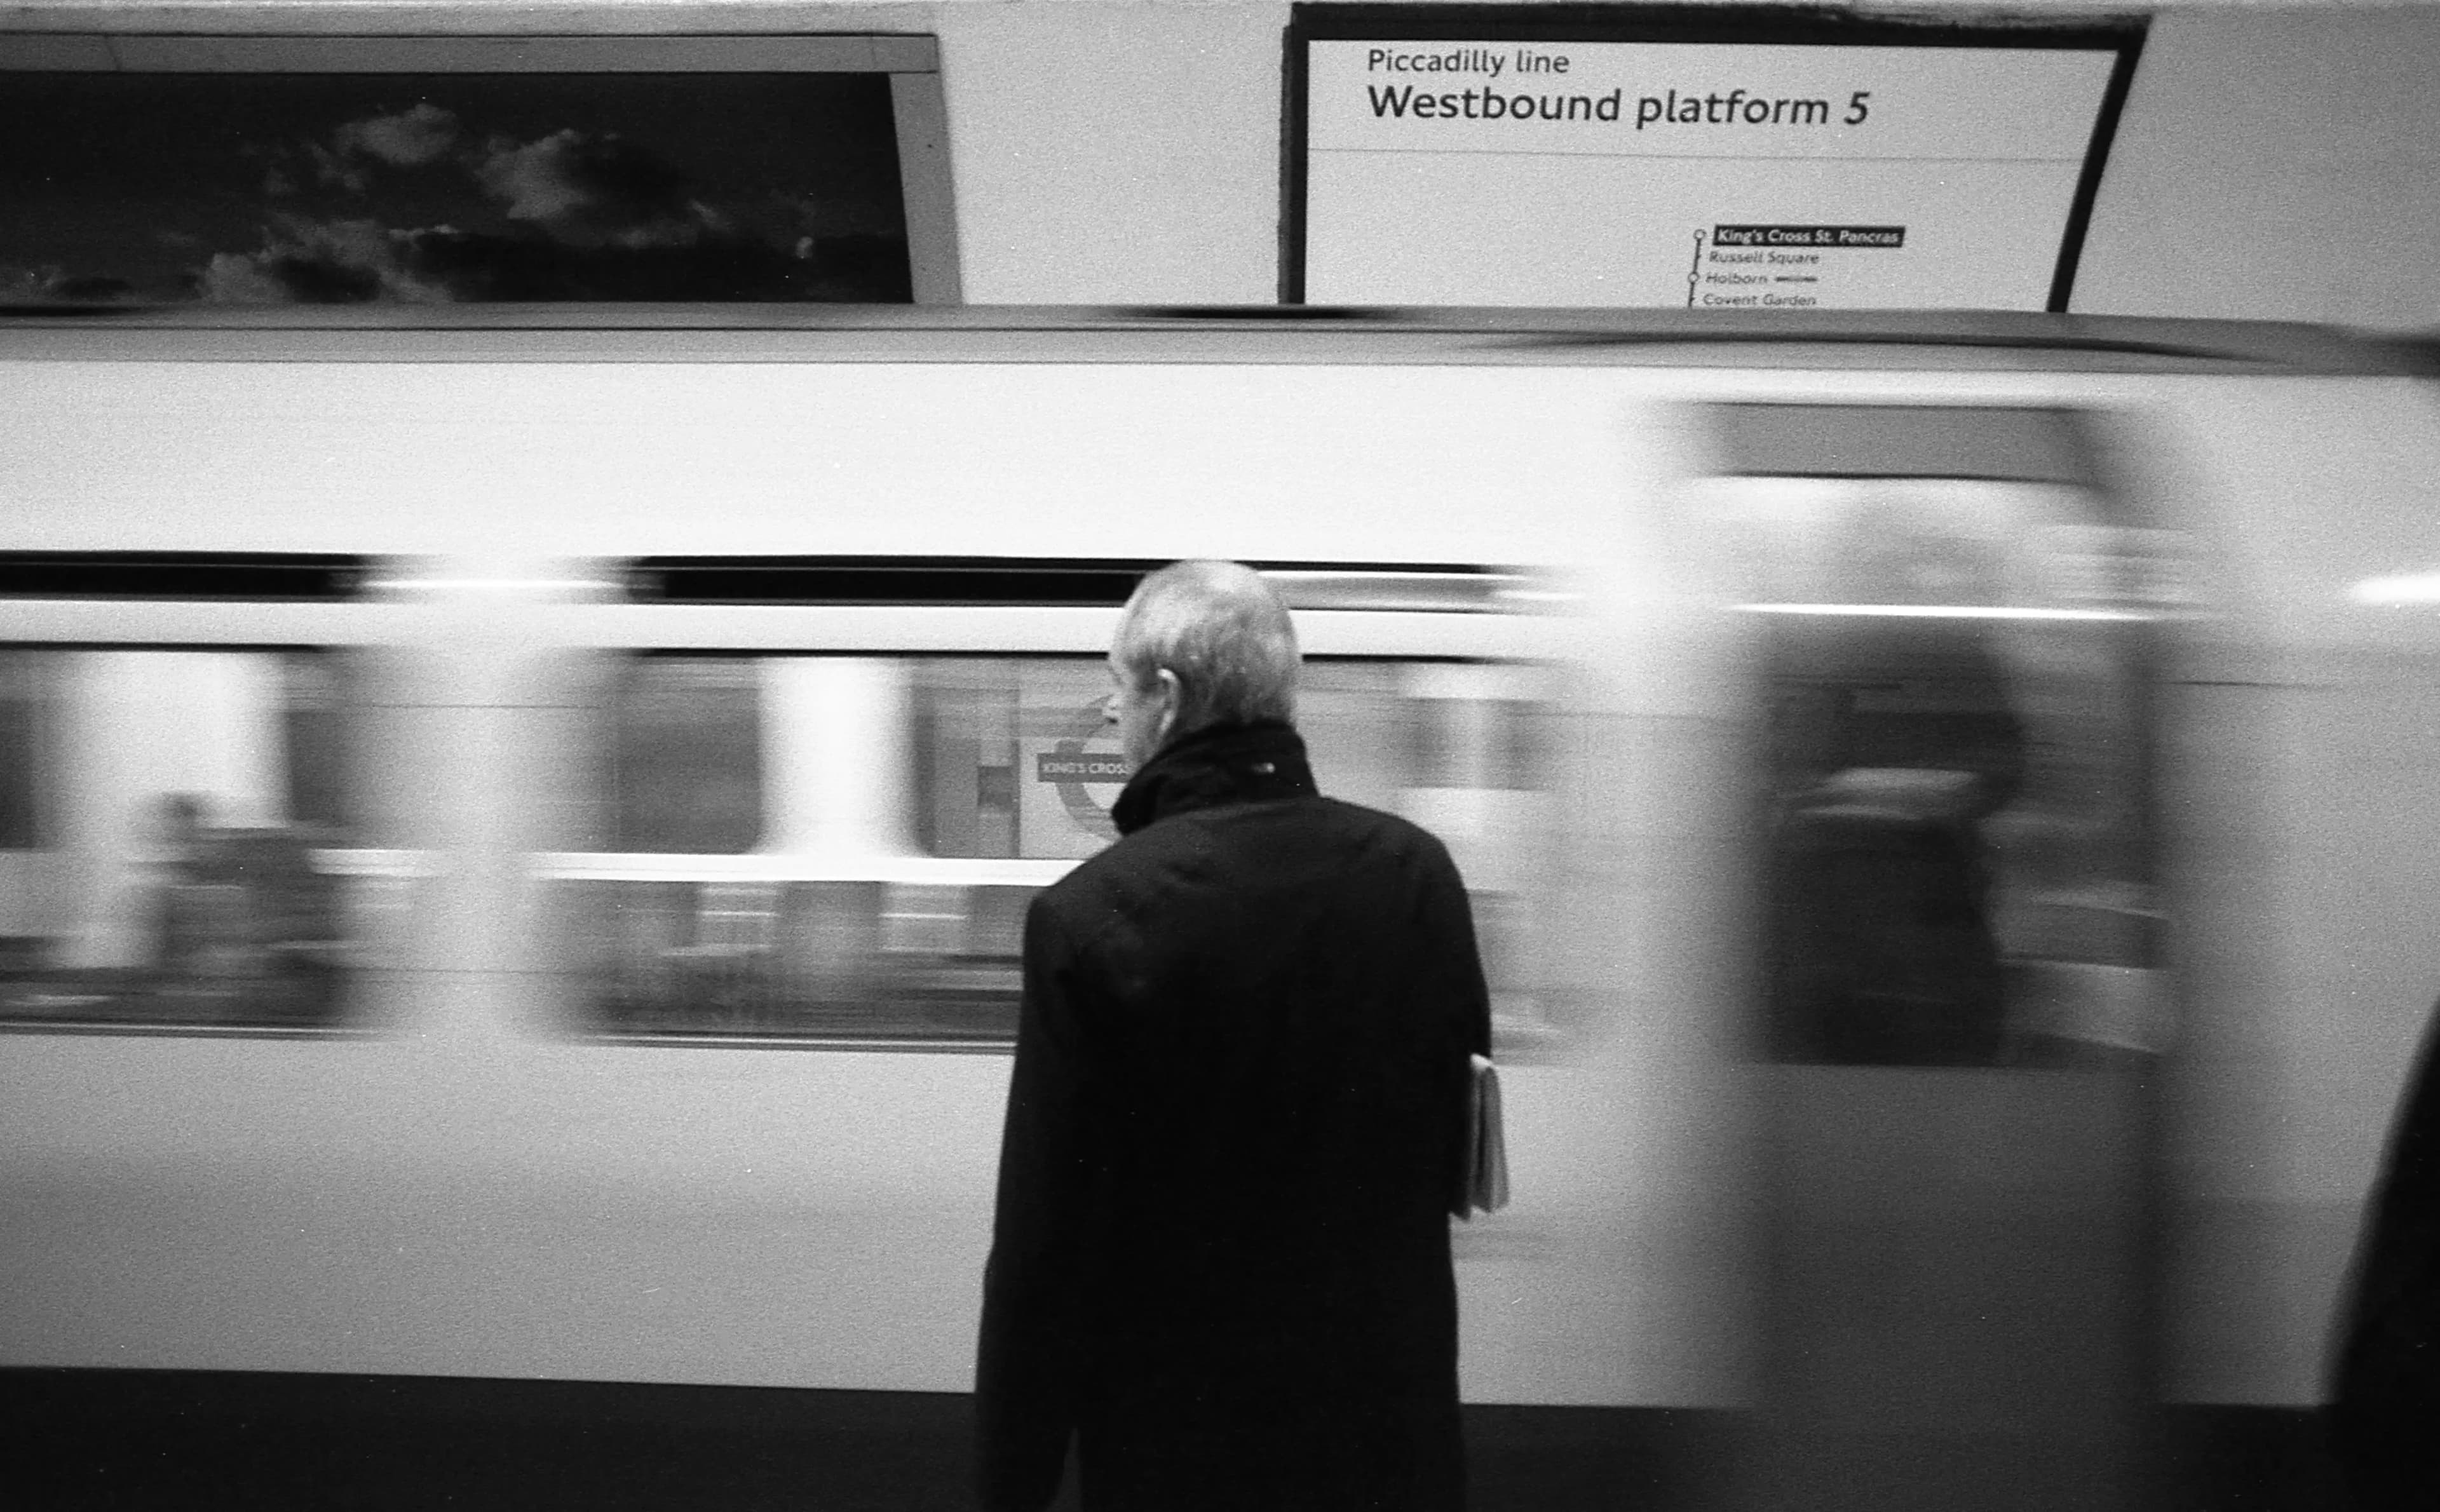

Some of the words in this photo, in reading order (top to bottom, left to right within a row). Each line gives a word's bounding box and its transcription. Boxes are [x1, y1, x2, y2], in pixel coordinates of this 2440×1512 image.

[1367, 49, 1505, 78] Piccadilly
[1516, 50, 1569, 72] line
[1367, 85, 1621, 121] Westbound
[1636, 89, 1829, 130] platform
[1843, 91, 1870, 125] 5
[1718, 227, 1763, 245] King's
[1768, 229, 1810, 243] Cross
[1839, 230, 1900, 244] Pancras
[1709, 252, 1763, 263] Russell
[1767, 252, 1819, 266] Square
[1706, 274, 1768, 284] Holborn
[1703, 295, 1758, 306] Covent
[1763, 295, 1816, 306] Garden
[1043, 762, 1086, 774] KING'S
